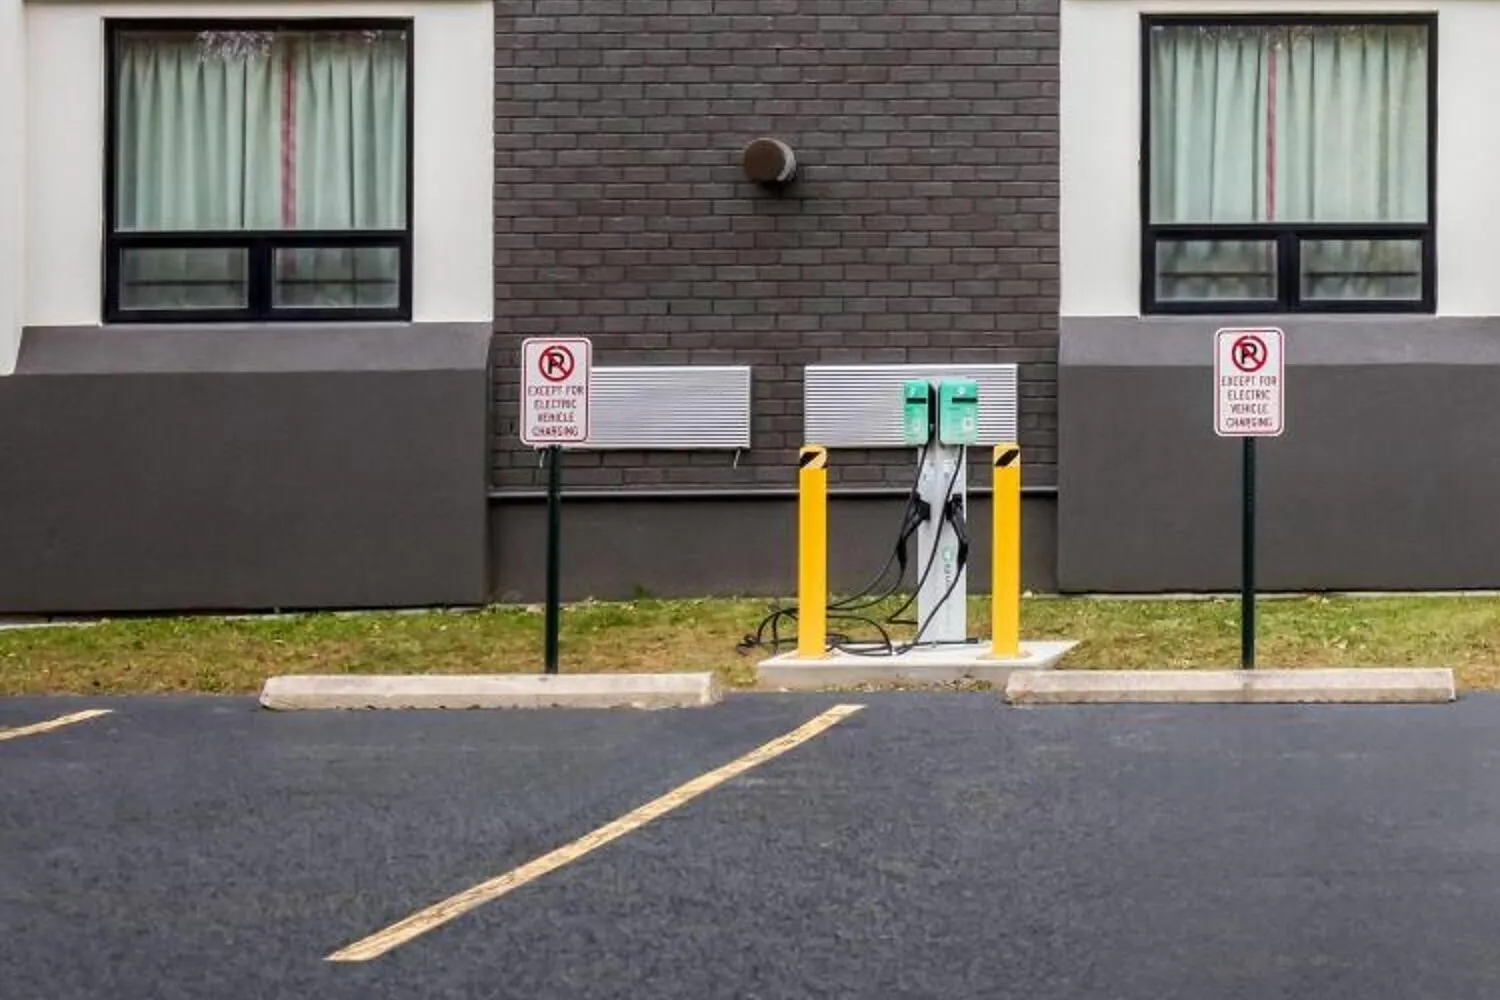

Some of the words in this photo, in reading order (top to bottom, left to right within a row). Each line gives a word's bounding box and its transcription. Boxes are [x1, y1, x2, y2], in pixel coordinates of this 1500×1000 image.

[1222, 376, 1255, 386] EXCEPT
[1260, 376, 1277, 386] FOR
[528, 386, 562, 396] EXCEPT
[566, 386, 584, 396] FOR
[1227, 390, 1271, 400] ELECTRIC
[534, 400, 576, 409] ELECTRIC
[1230, 403, 1268, 414] VEHICLE
[538, 412, 575, 422] VEHICLE
[1226, 417, 1273, 428] CHARGING
[532, 426, 579, 436] CHARGING
